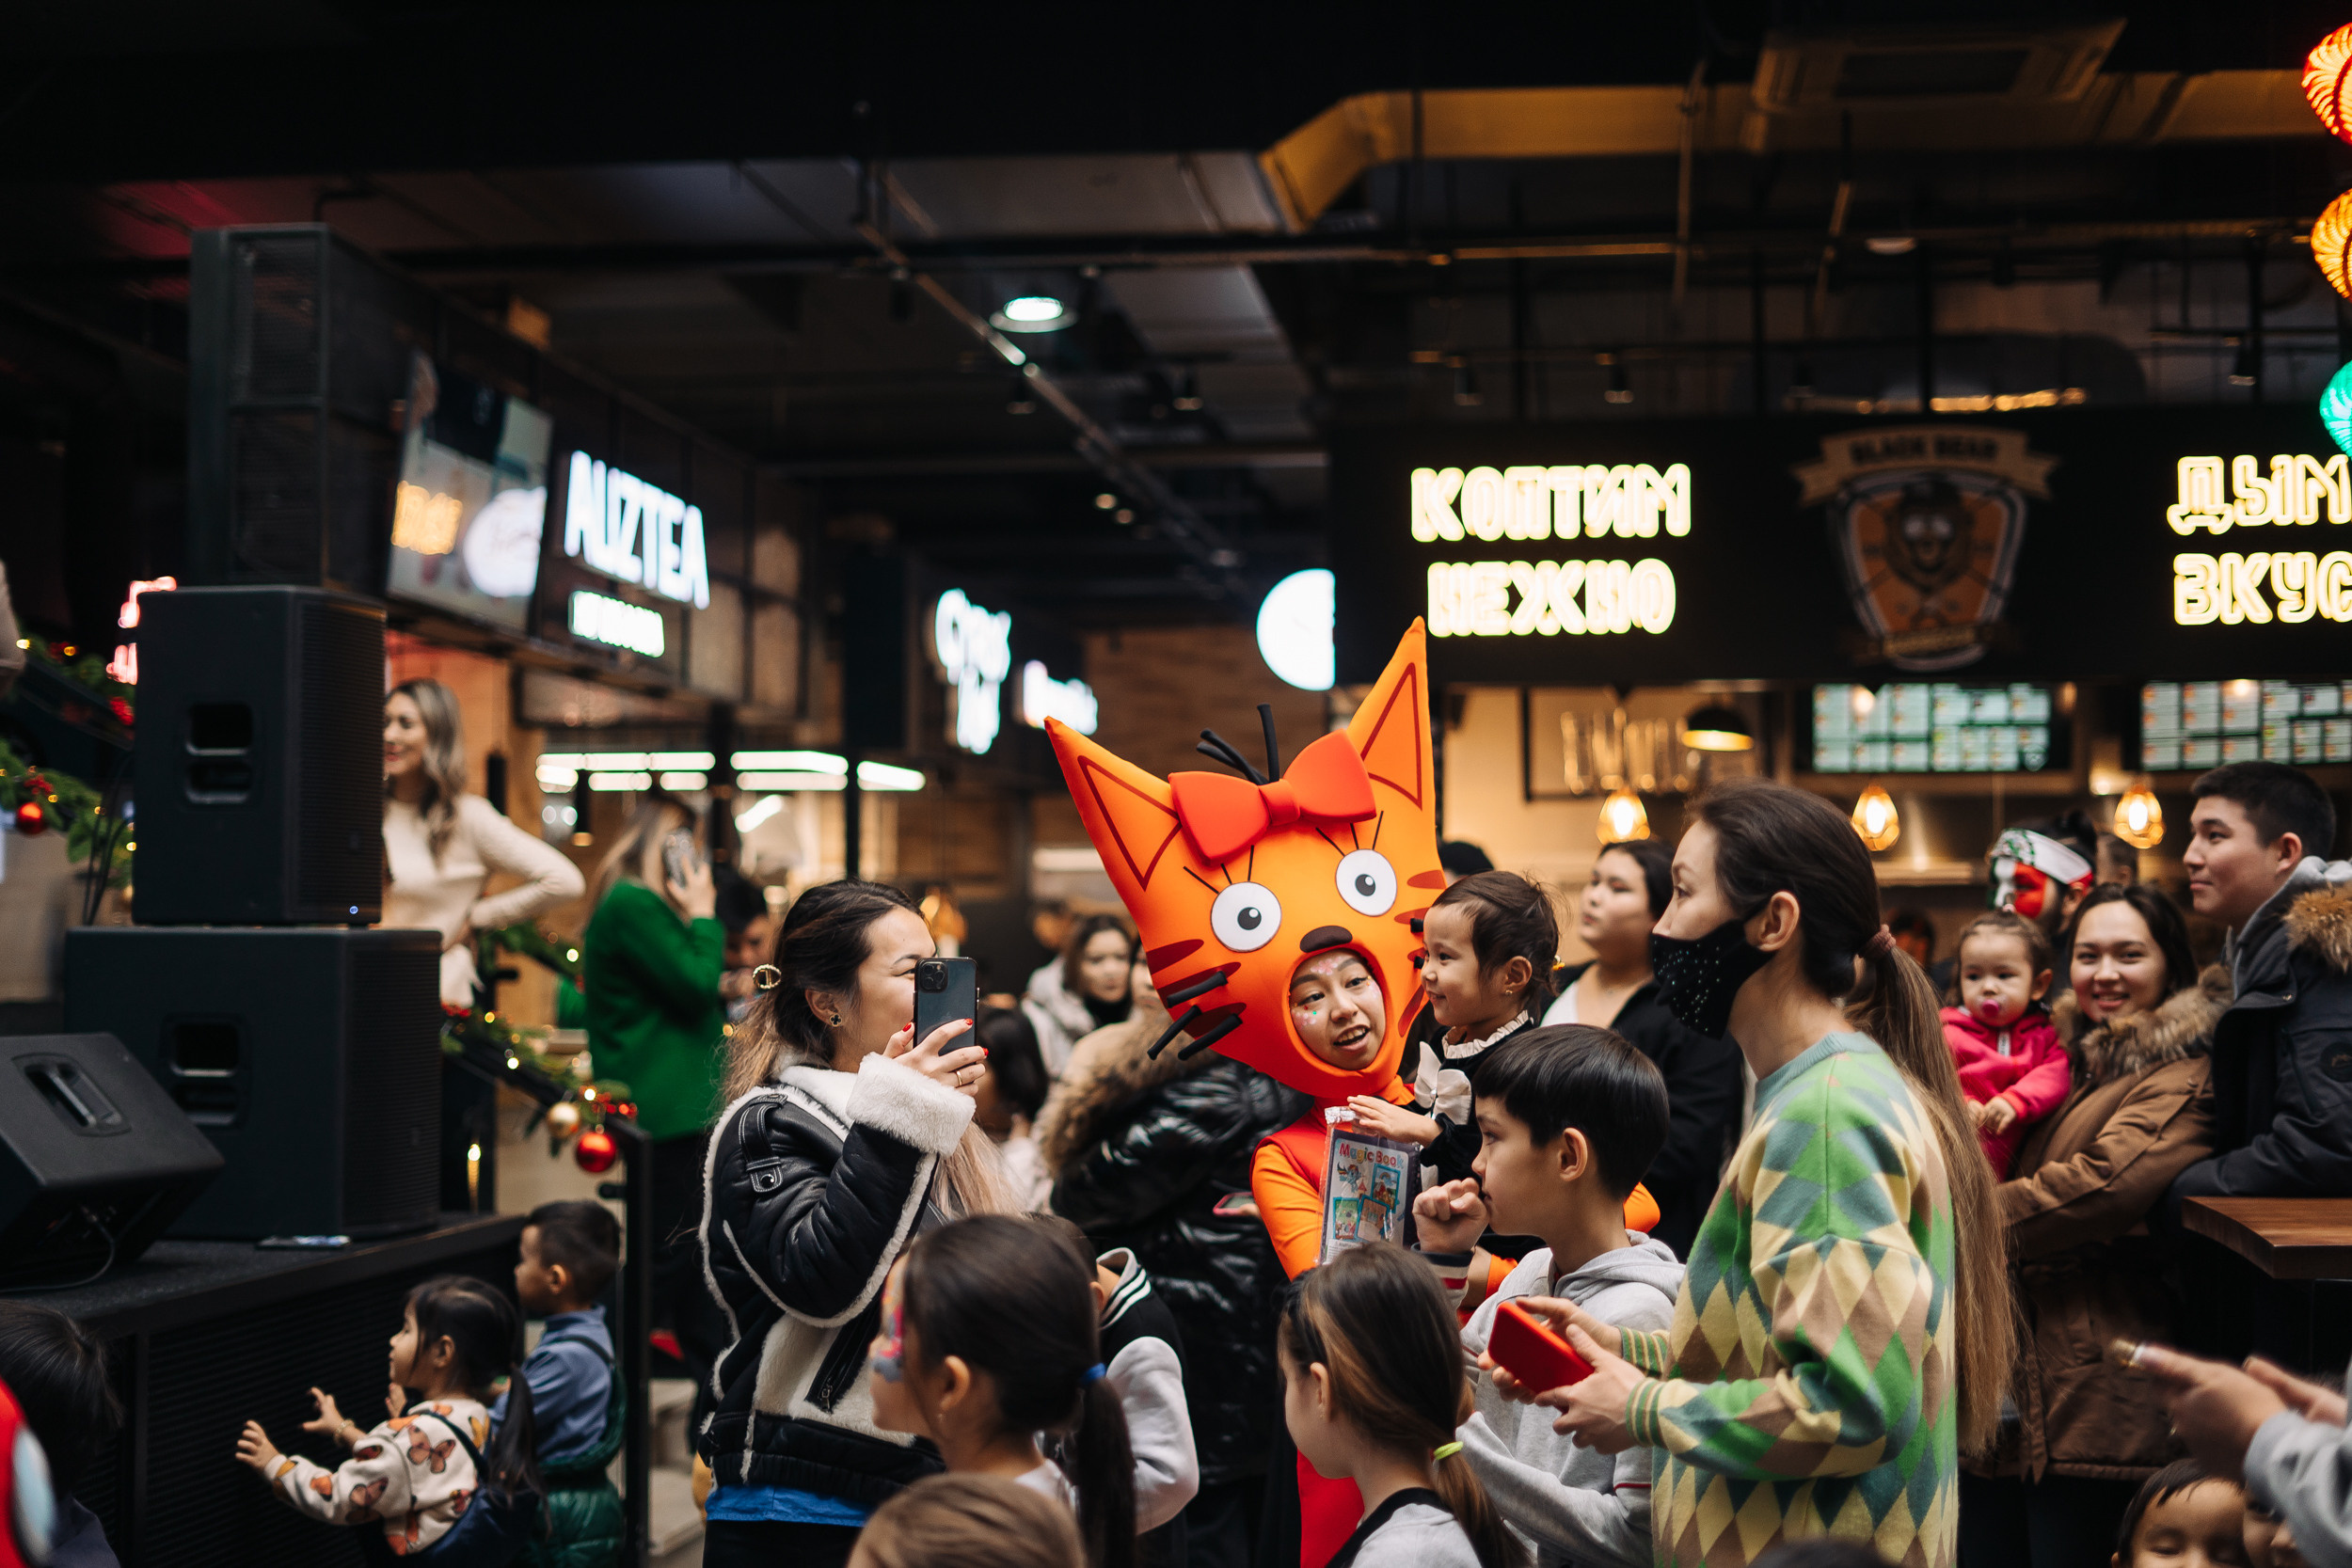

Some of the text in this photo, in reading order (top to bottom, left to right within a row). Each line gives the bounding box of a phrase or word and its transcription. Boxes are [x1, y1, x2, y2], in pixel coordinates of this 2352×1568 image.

[1410, 463, 1692, 543] КОПТИМ
[1427, 558, 1677, 638] НЕЖНО
[2173, 550, 2352, 626] ВКУС
[1339, 1142, 1405, 1169] Magic Book
